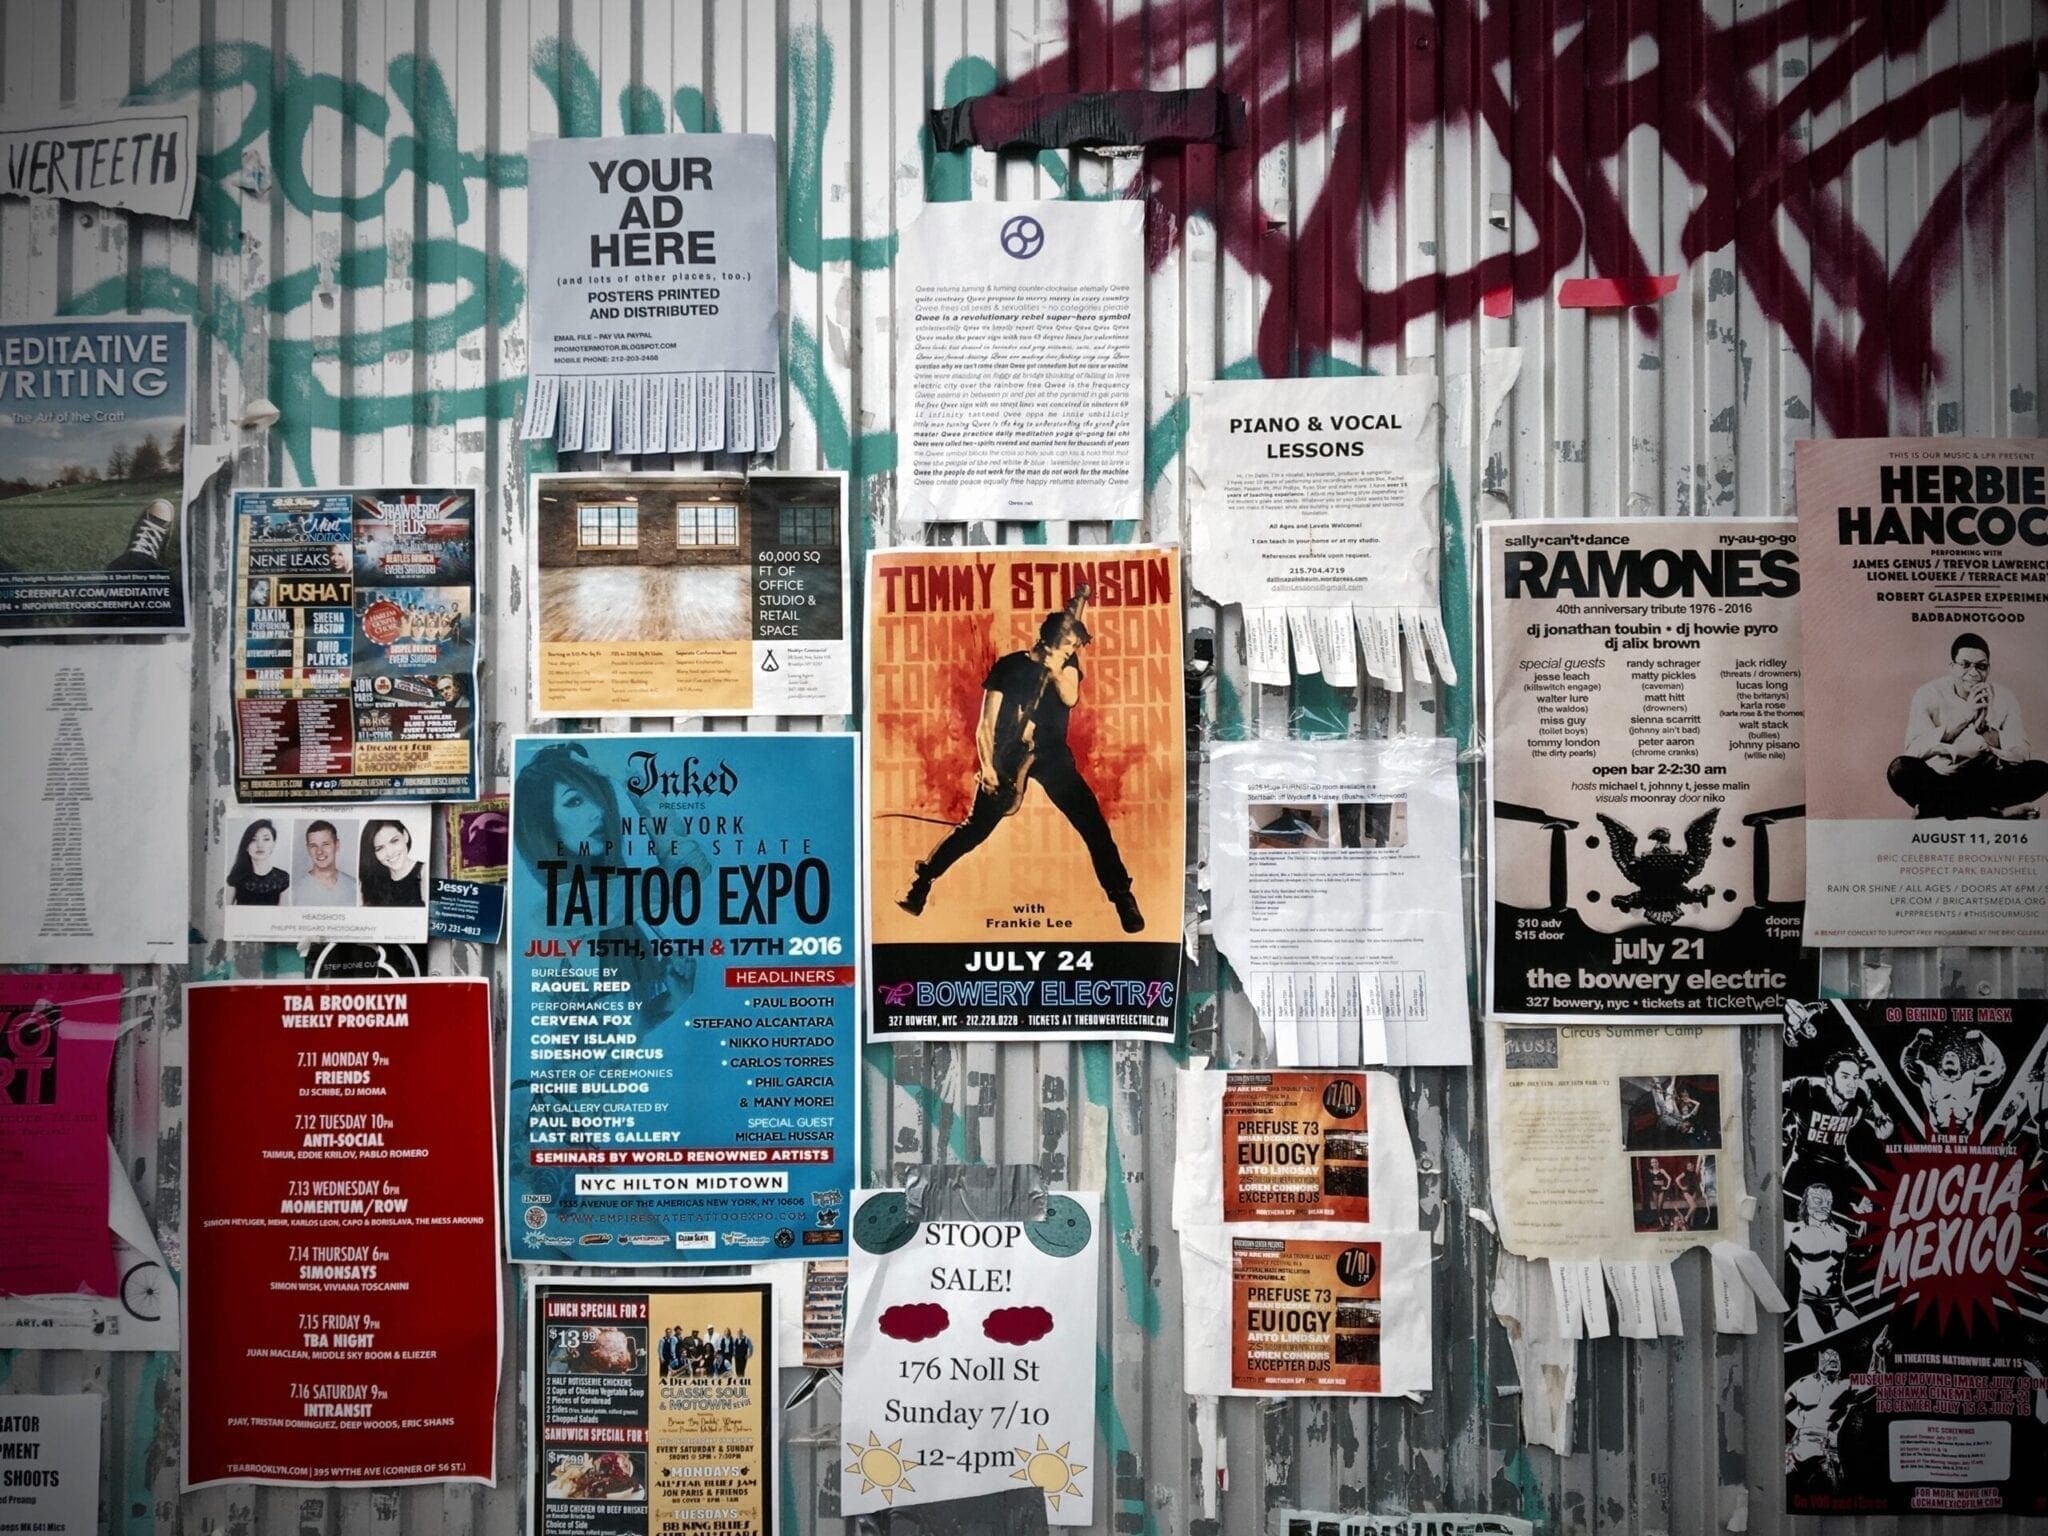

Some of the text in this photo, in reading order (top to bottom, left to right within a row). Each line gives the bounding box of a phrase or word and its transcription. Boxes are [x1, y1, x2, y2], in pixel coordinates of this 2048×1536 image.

[589, 157, 713, 193] YOUR
[619, 195, 683, 229] AD
[590, 231, 716, 267] HERE
[557, 271, 751, 285] (and lots of other places, too.)
[588, 288, 720, 303] POSTERS PRINTED
[590, 305, 719, 319] AND DISTRIBUTED
[915, 314, 940, 322] Qwee
[960, 313, 1018, 322] revolutionary
[1021, 313, 1044, 321] rebel
[1047, 313, 1096, 322] super-hero
[1099, 312, 1130, 321] symbol
[13, 411, 124, 423] The Art of the Craft
[1230, 414, 1402, 433] PIANO & VOCAL
[1268, 442, 1364, 458] LESSONS
[1880, 466, 2046, 504] HERBIE
[377, 502, 440, 520] STRAWBERRY
[393, 521, 425, 535] FIELDS
[1720, 534, 1796, 545] ny-au-go-go
[251, 553, 329, 567] NENE LEAKS
[759, 551, 820, 563] 60,000 SQ
[759, 566, 795, 576] FT OF
[1504, 550, 1800, 598] RAMONES
[759, 580, 804, 590] OFFICE
[880, 558, 1170, 613] TOMMY STINSON
[279, 583, 350, 602] PUSHA T
[759, 595, 816, 606] STUDIO &
[760, 610, 800, 621] RETAIL
[1556, 604, 1752, 616] 40th anniversary tribute 1976 2016
[1912, 613, 2025, 623] BADBADNOTGOOD
[760, 625, 798, 636] SPACE
[1527, 623, 1778, 637] dj jonathan toubin dj howie pyro
[317, 641, 339, 653] OHIO
[307, 653, 348, 666] PLAYERS
[1528, 738, 1600, 748] tommy london
[627, 750, 738, 797] Inked
[622, 817, 744, 835] NEW YORK
[1912, 834, 2027, 845] AUGUST 11, 2016
[1900, 867, 2037, 875] PROSPECT PARK BANDSHELL
[437, 881, 479, 896] Jessy's
[538, 857, 830, 926] TATTOO EXPO
[1014, 904, 1045, 913] with
[986, 918, 1072, 928] Frankie Lee
[524, 937, 842, 959] JULY 15TH, 16TH & 17TH 2016
[1613, 938, 1705, 965] july 21
[966, 951, 1094, 971] JULY 24
[736, 970, 835, 983] HEADLINERS
[1526, 969, 1786, 994] the bowery electric
[917, 982, 1033, 1006] BOWERY
[284, 994, 407, 1012] TBA BROOKLYN
[282, 1014, 408, 1028] WEEKLY PROGRAM
[1886, 1008, 2012, 1022] GO BEHIND THE MASK
[1561, 1025, 1703, 1039] Circus Summer Camp
[298, 1052, 317, 1067] 7.11
[322, 1052, 368, 1067] MONDAY
[315, 1071, 370, 1084] FRIENDS
[1238, 1121, 1319, 1135] PREFUSE 73
[304, 1134, 384, 1147] ANTI-SOCIAL
[536, 1150, 828, 1163] SEMINARS BY WORLD RENOWNED ARTISTS
[581, 1177, 783, 1191] NYC HILTON MIDTOWN
[1889, 1159, 2024, 1230] LUCHA
[926, 1223, 1021, 1248] STOOP
[1874, 1212, 2022, 1299] MEXICO
[931, 1267, 1011, 1293] SALE!
[548, 1303, 646, 1318] LUNCH SPECIAL FOR 2
[899, 1357, 1040, 1383] 176 Noll St
[1248, 1359, 1331, 1372] EXCEPTER DJS
[885, 1399, 1050, 1429] Sunday 7/10
[917, 1448, 1015, 1473] 12-4pm
[4, 1470, 59, 1487] SHOOTS
[671, 1466, 740, 1477] MONDAYS
